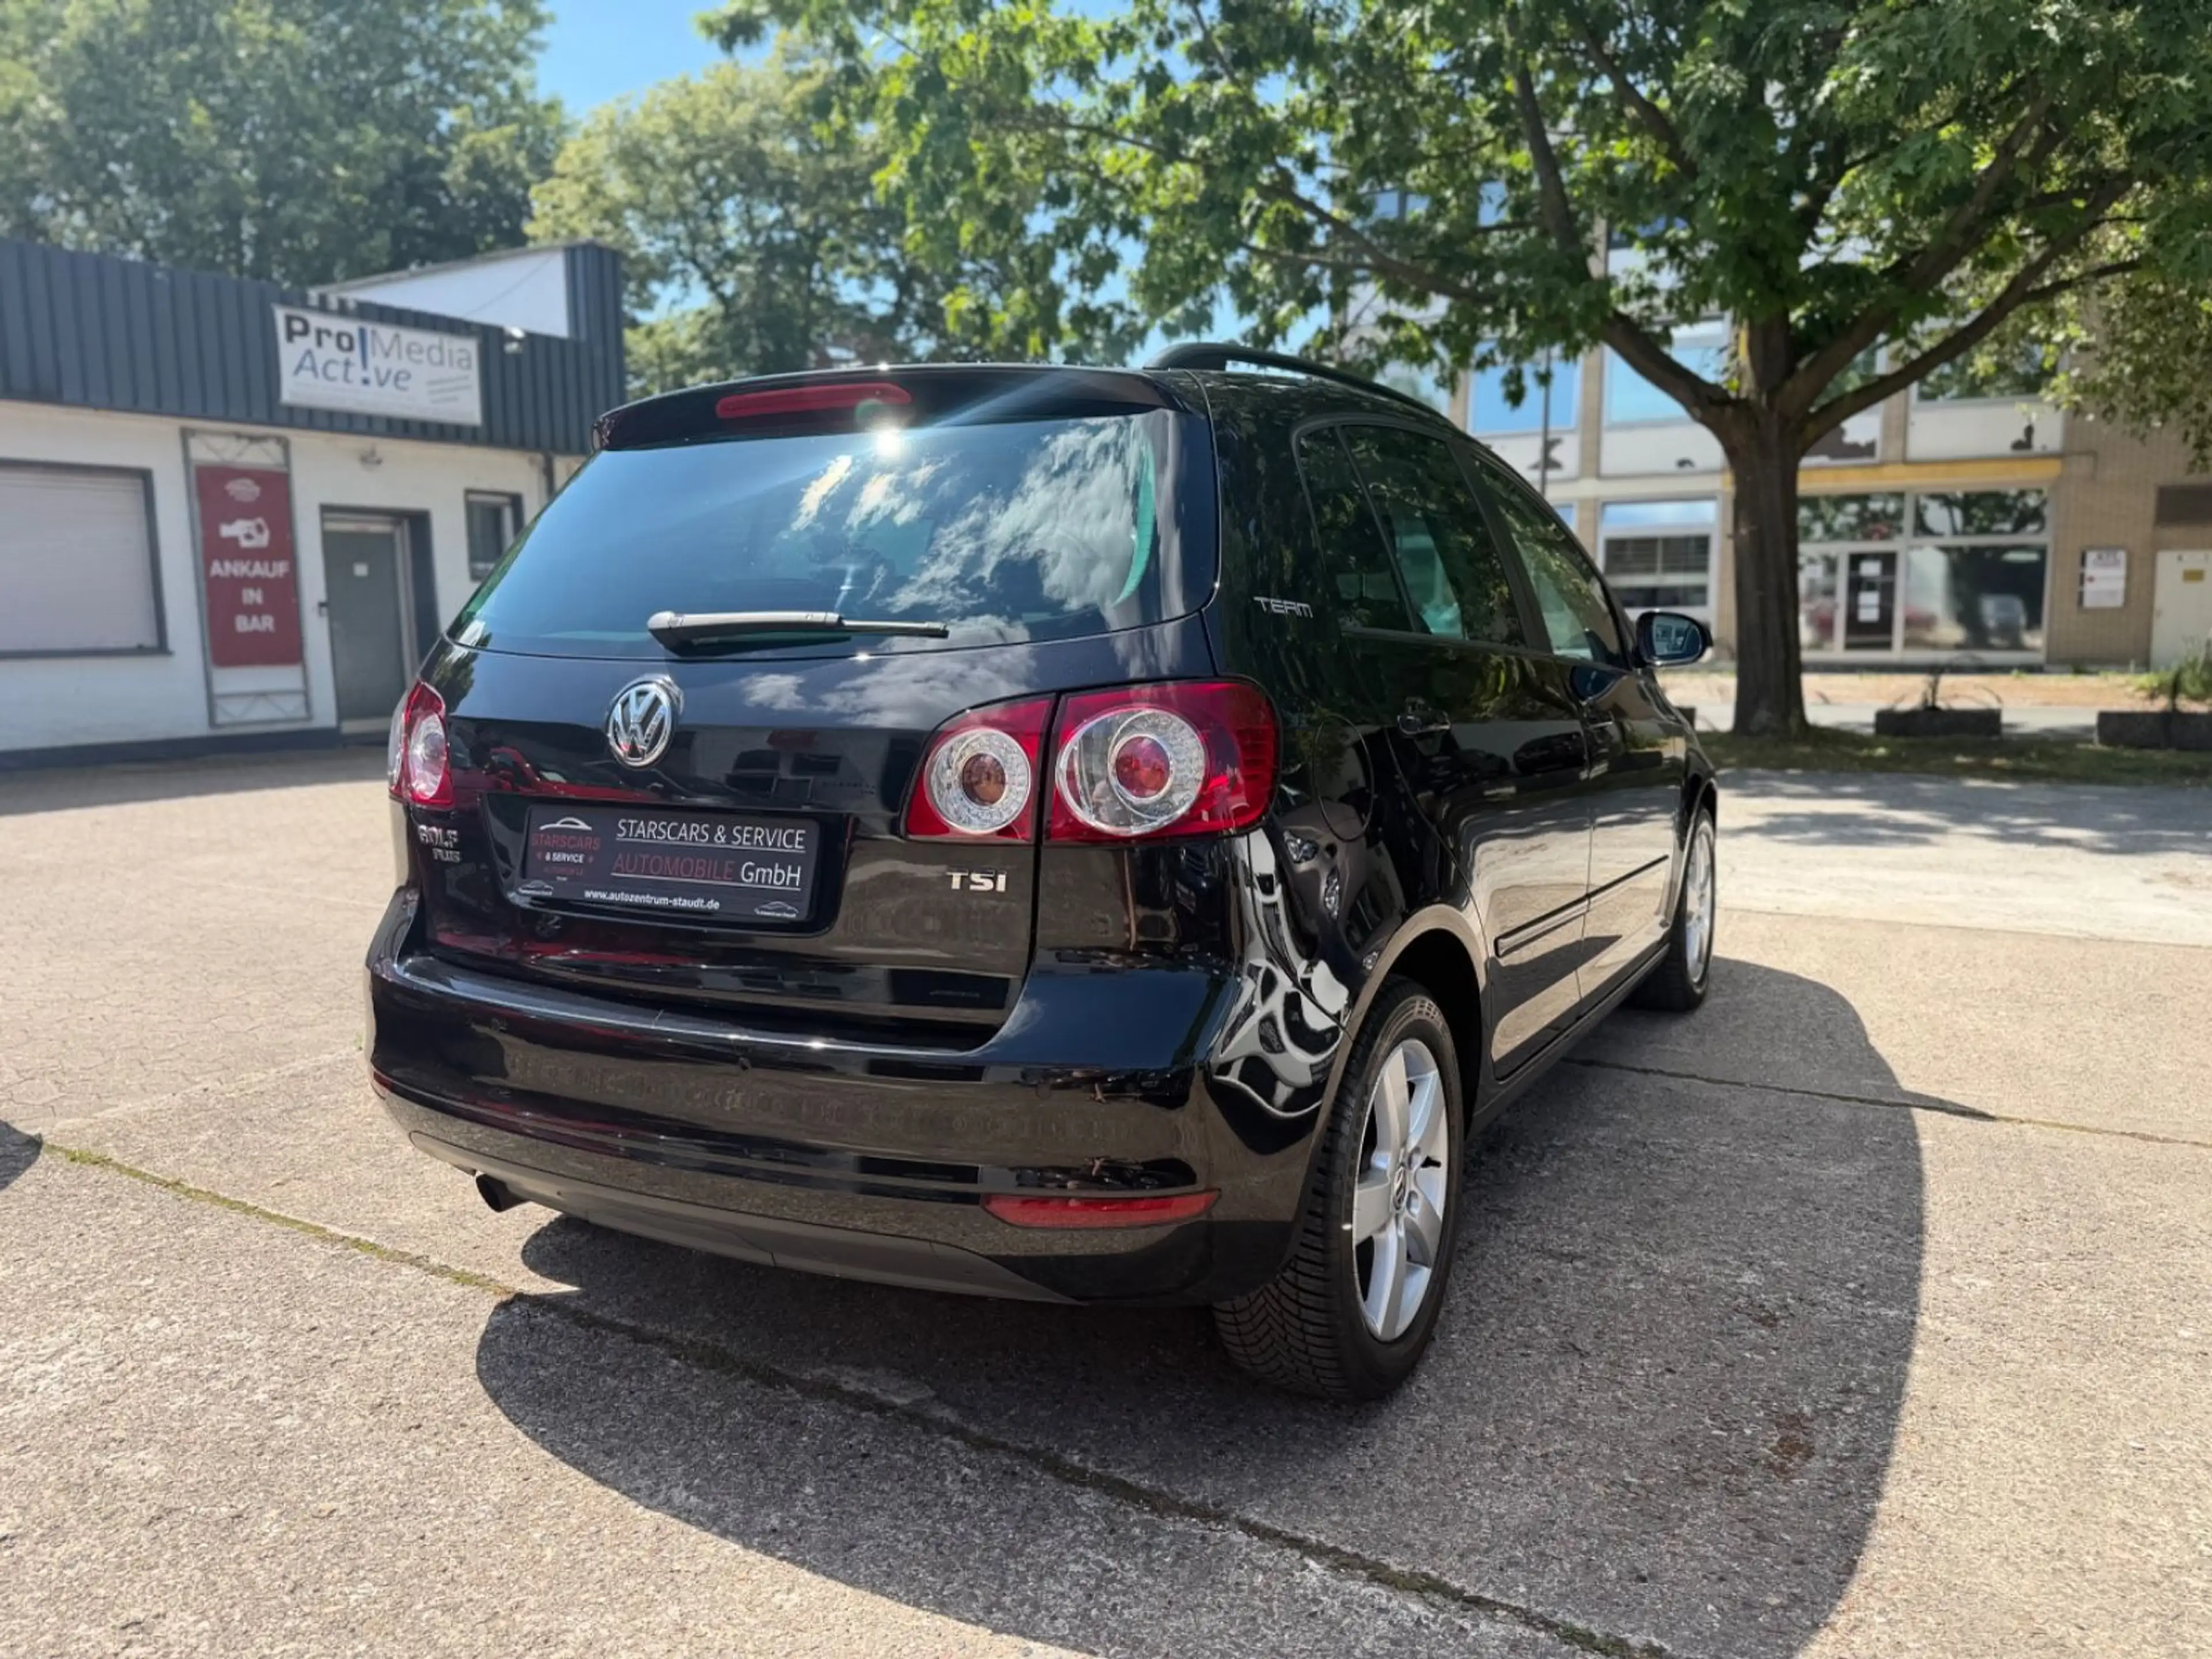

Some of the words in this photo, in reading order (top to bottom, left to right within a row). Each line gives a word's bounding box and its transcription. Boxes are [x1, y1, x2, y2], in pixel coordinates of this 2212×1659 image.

[370, 328, 472, 372] Media
[210, 558, 290, 579] ANKAUF
[242, 586, 264, 606] IN
[1253, 596, 1313, 619] TEAM
[234, 613, 275, 633] BAR
[531, 833, 600, 850] STARSCARS
[617, 819, 710, 843] STARSCARS
[713, 824, 726, 844] &
[731, 825, 806, 849] SERVICE
[552, 852, 585, 864] SERVICE
[613, 853, 736, 880] AUTOMOBILE
[741, 861, 801, 887] GmbH
[946, 870, 1007, 892] TSI
[584, 889, 721, 910] www.autozentrum-staudt.de
